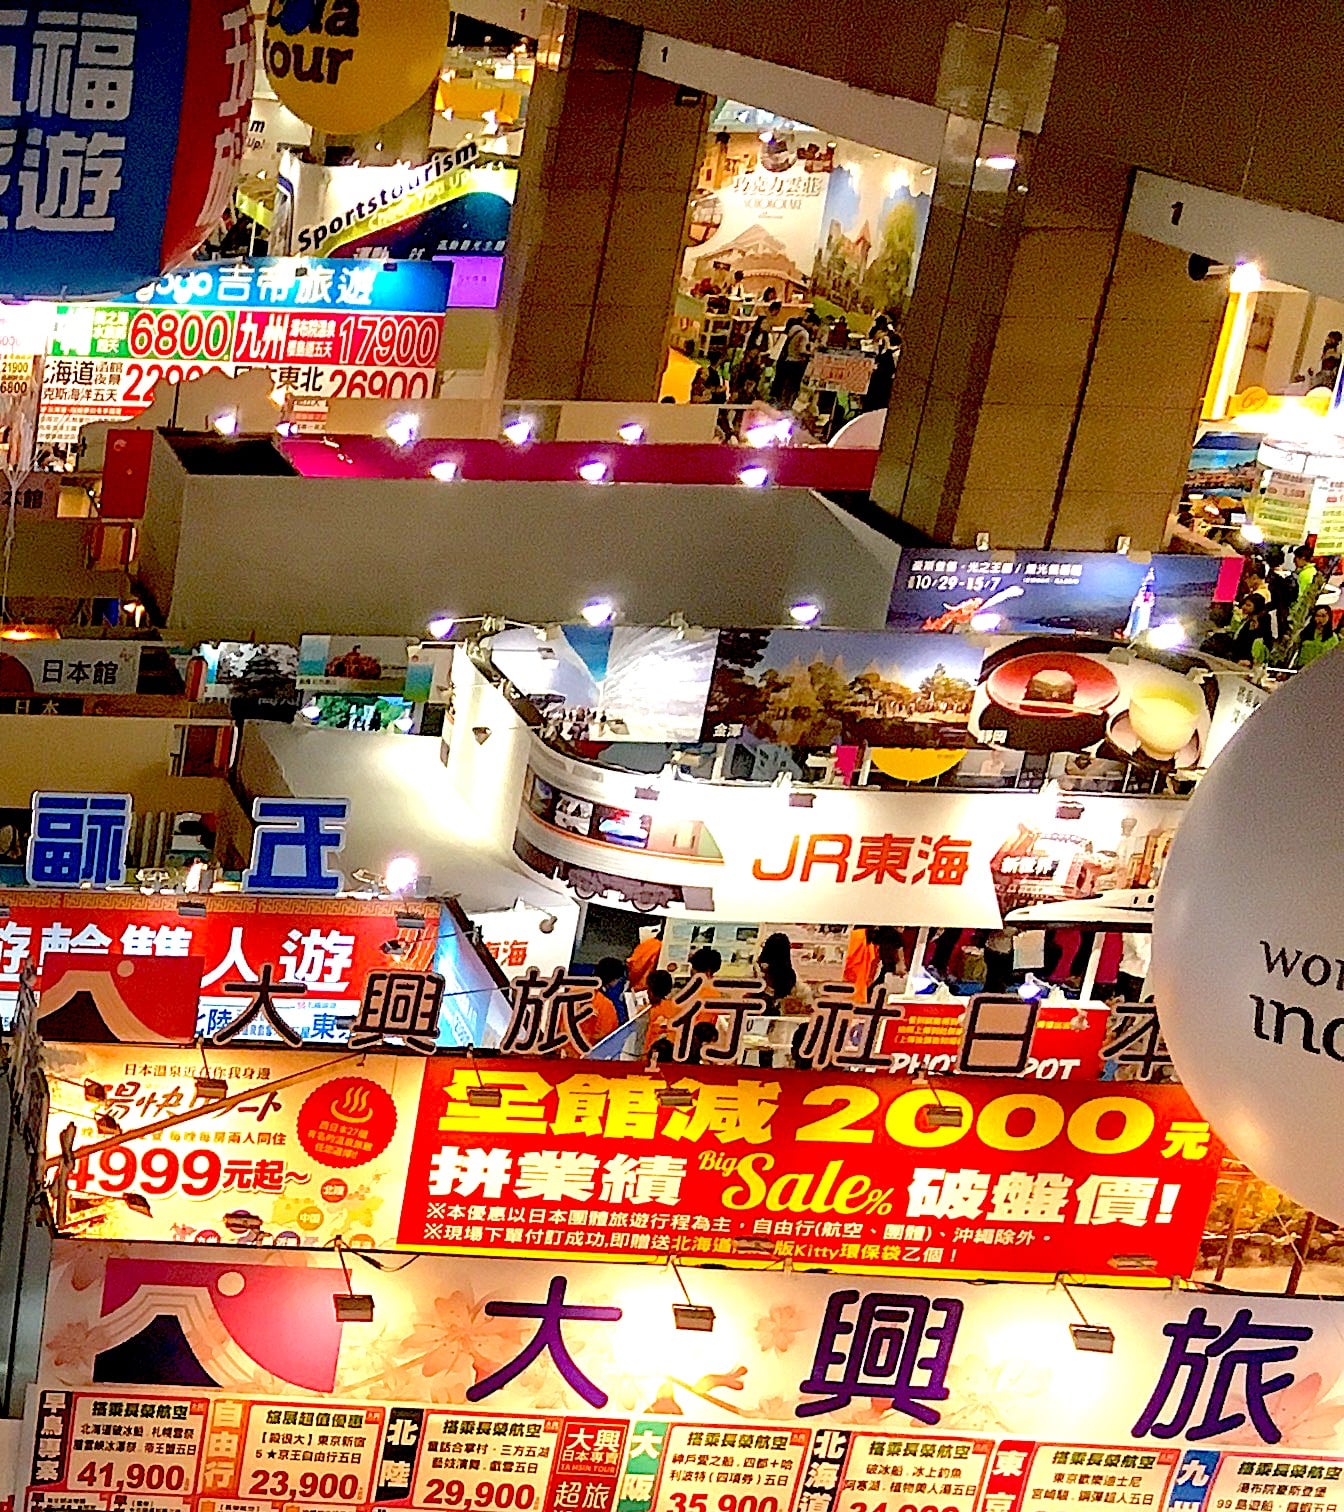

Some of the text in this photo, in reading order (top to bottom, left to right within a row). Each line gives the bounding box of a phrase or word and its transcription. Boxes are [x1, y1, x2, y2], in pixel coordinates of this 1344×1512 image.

[267, 42, 353, 86] tour
[297, 141, 478, 251] Sportstourism
[1170, 201, 1184, 226] 1
[128, 312, 229, 358] 6800
[237, 313, 439, 366] 九州 17900
[42, 659, 118, 686] 日本館
[752, 833, 972, 886] JR東海
[427, 1146, 689, 1206] 拼業績
[698, 1150, 739, 1182] Big
[905, 1168, 1180, 1227] 破盤價!
[266, 1409, 364, 1429] 旅展超值優惠
[443, 1418, 542, 1438] 搭乘長榮航空
[204, 1400, 244, 1488] 自由行
[378, 1419, 419, 1489] 北陸
[566, 1429, 621, 1451] 大興
[687, 1431, 790, 1451] 搭乘長榮航空
[868, 1440, 971, 1460] 搭乘長榮航空
[77, 1460, 185, 1493] 41,900
[621, 1431, 661, 1502] 大阪
[1052, 1450, 1157, 1470] 搭乘長榮航空
[249, 1469, 359, 1500] 23,900
[423, 1478, 536, 1511] 29,900
